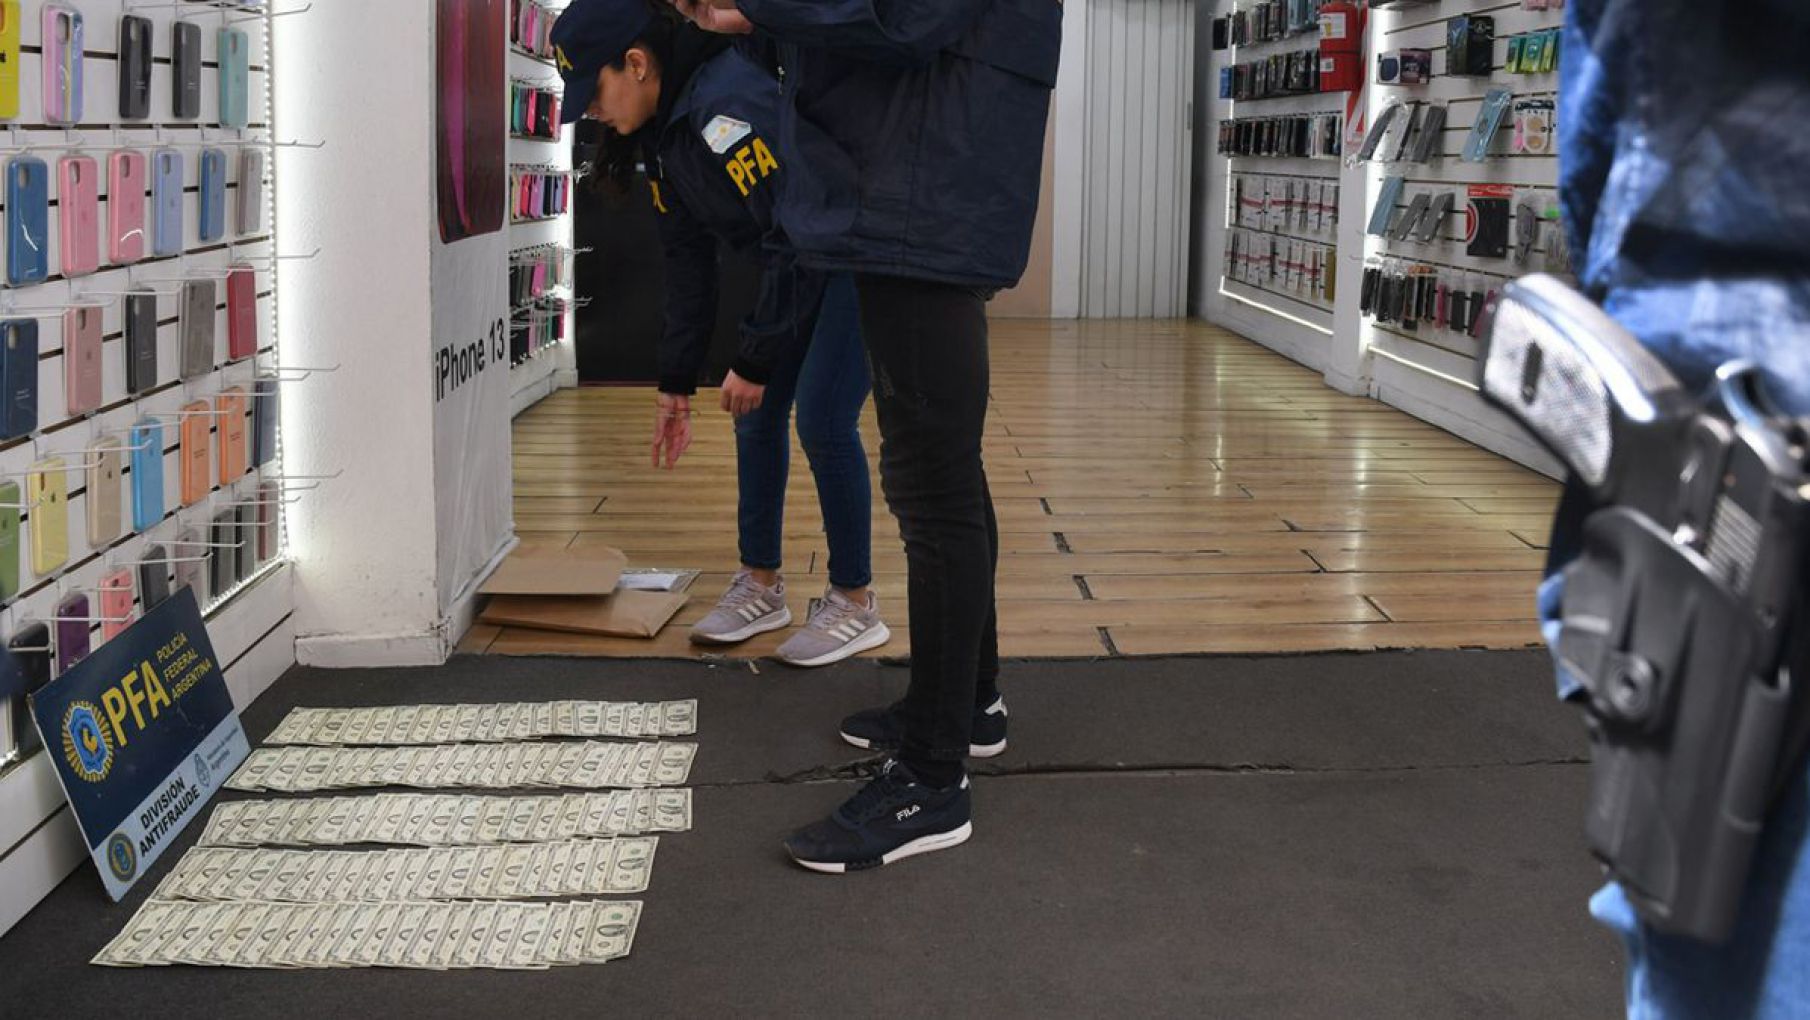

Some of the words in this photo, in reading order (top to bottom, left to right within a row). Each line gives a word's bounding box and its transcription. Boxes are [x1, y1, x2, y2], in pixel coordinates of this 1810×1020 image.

[725, 136, 779, 197] PFA
[435, 338, 485, 403] iPhone
[489, 317, 505, 364] 13
[163, 648, 199, 682] FEDERAL
[171, 657, 213, 700] ARGENTINA
[102, 659, 172, 747] PFA
[139, 786, 201, 857] ANTIFRAUDE
[140, 775, 187, 829] DIVISIÓN
[896, 804, 921, 821] FILA
